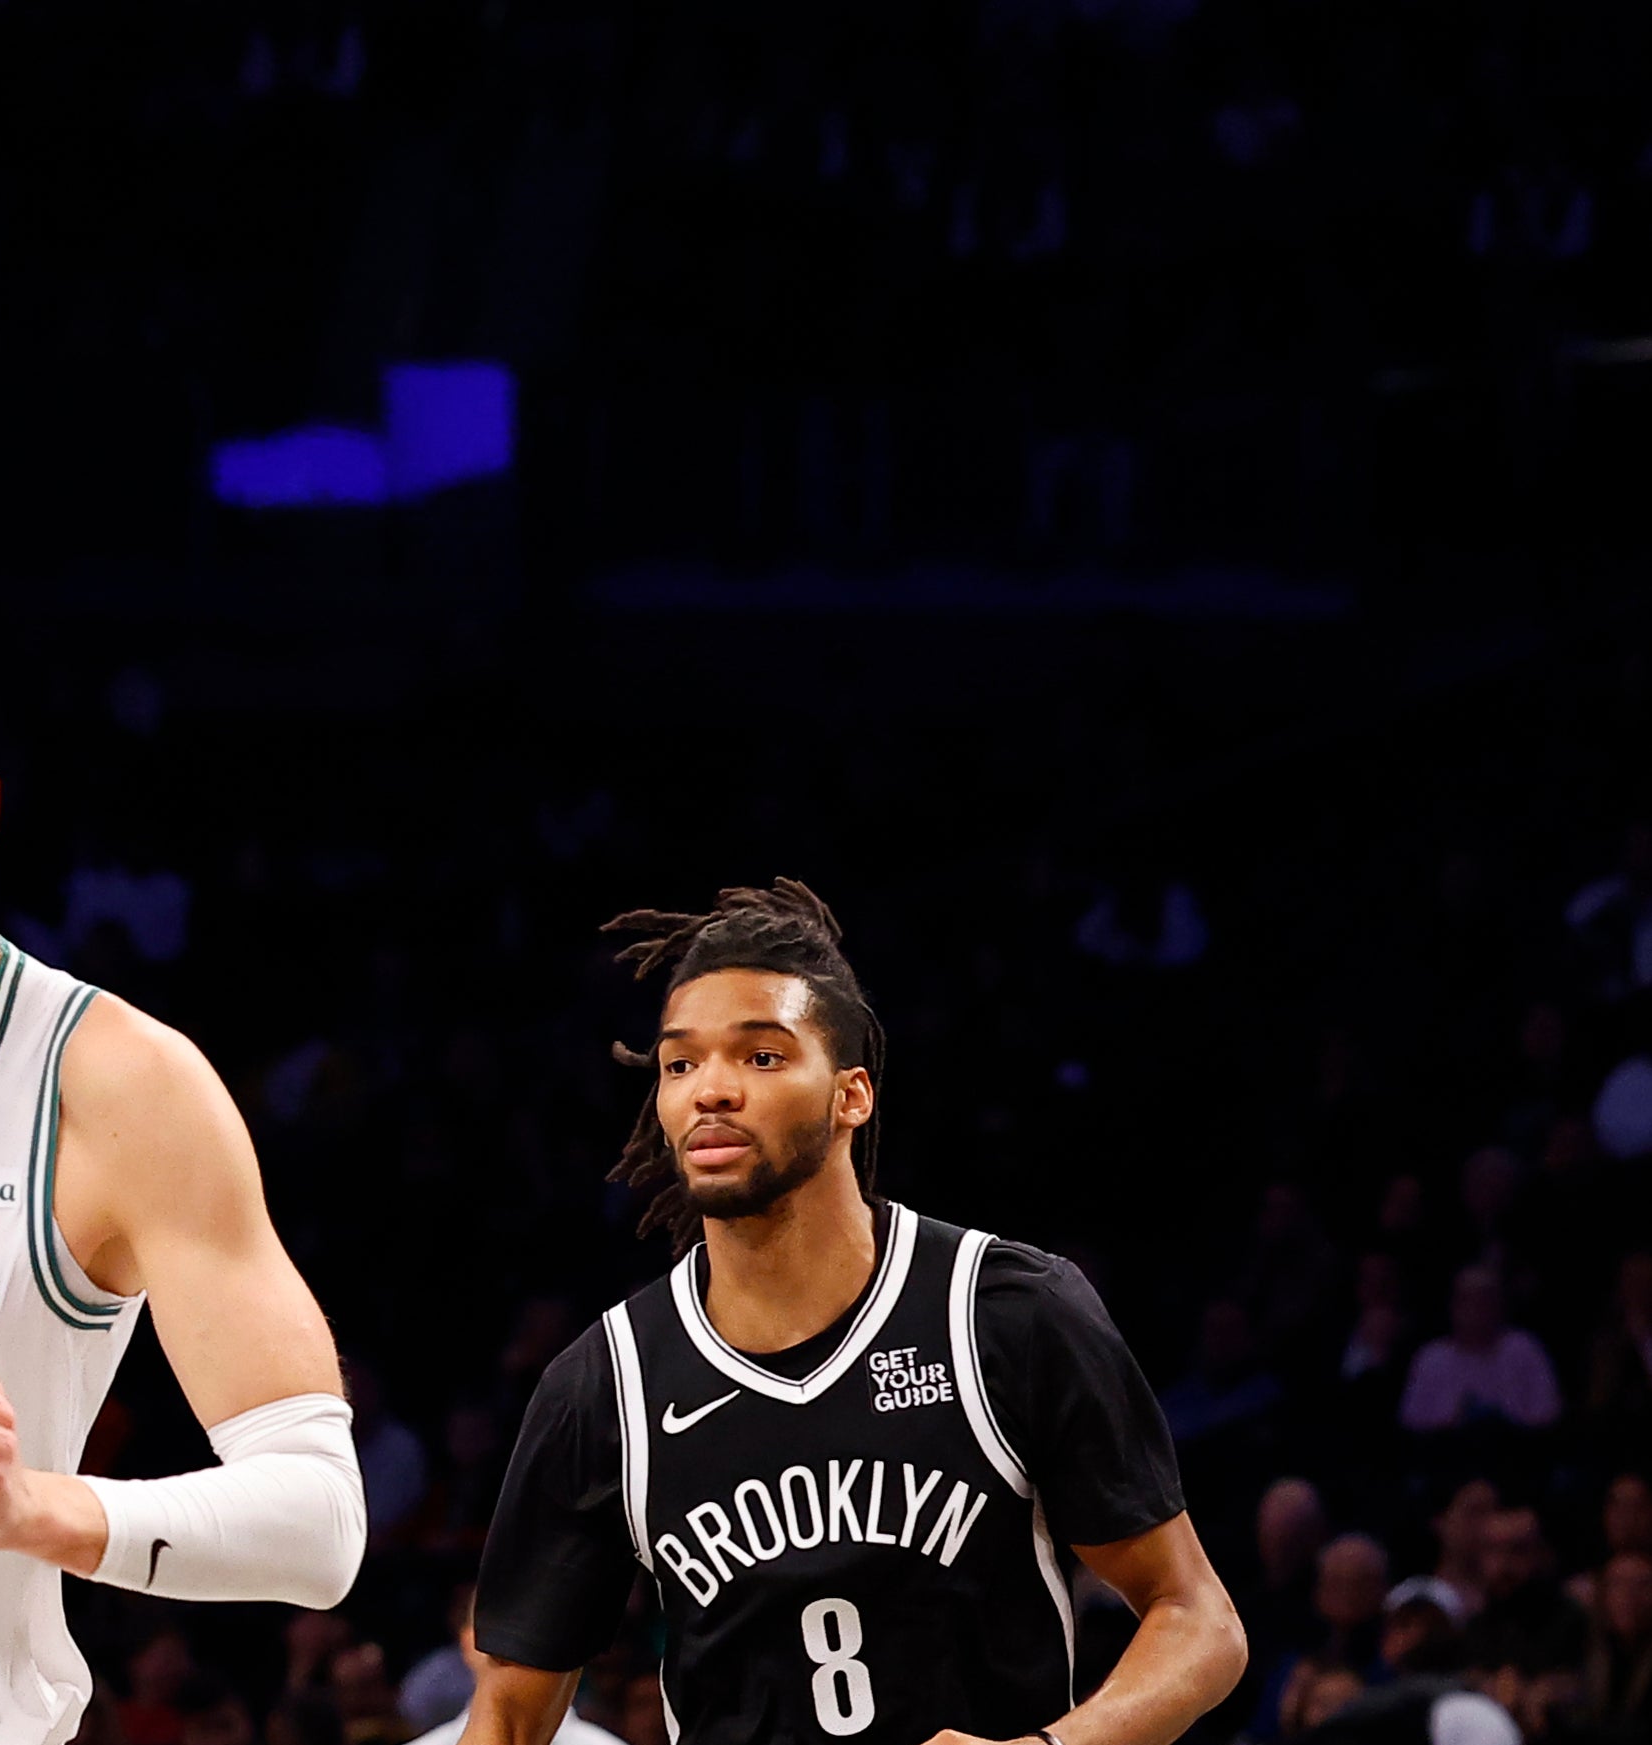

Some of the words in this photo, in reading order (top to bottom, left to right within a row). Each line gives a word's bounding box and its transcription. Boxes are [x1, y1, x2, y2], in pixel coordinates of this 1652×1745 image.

[869, 1346, 918, 1372] GET
[871, 1362, 947, 1391] YOUR
[874, 1381, 954, 1412] GUIDE
[654, 1458, 989, 1608] BROOKLYN
[801, 1597, 876, 1737] 8
